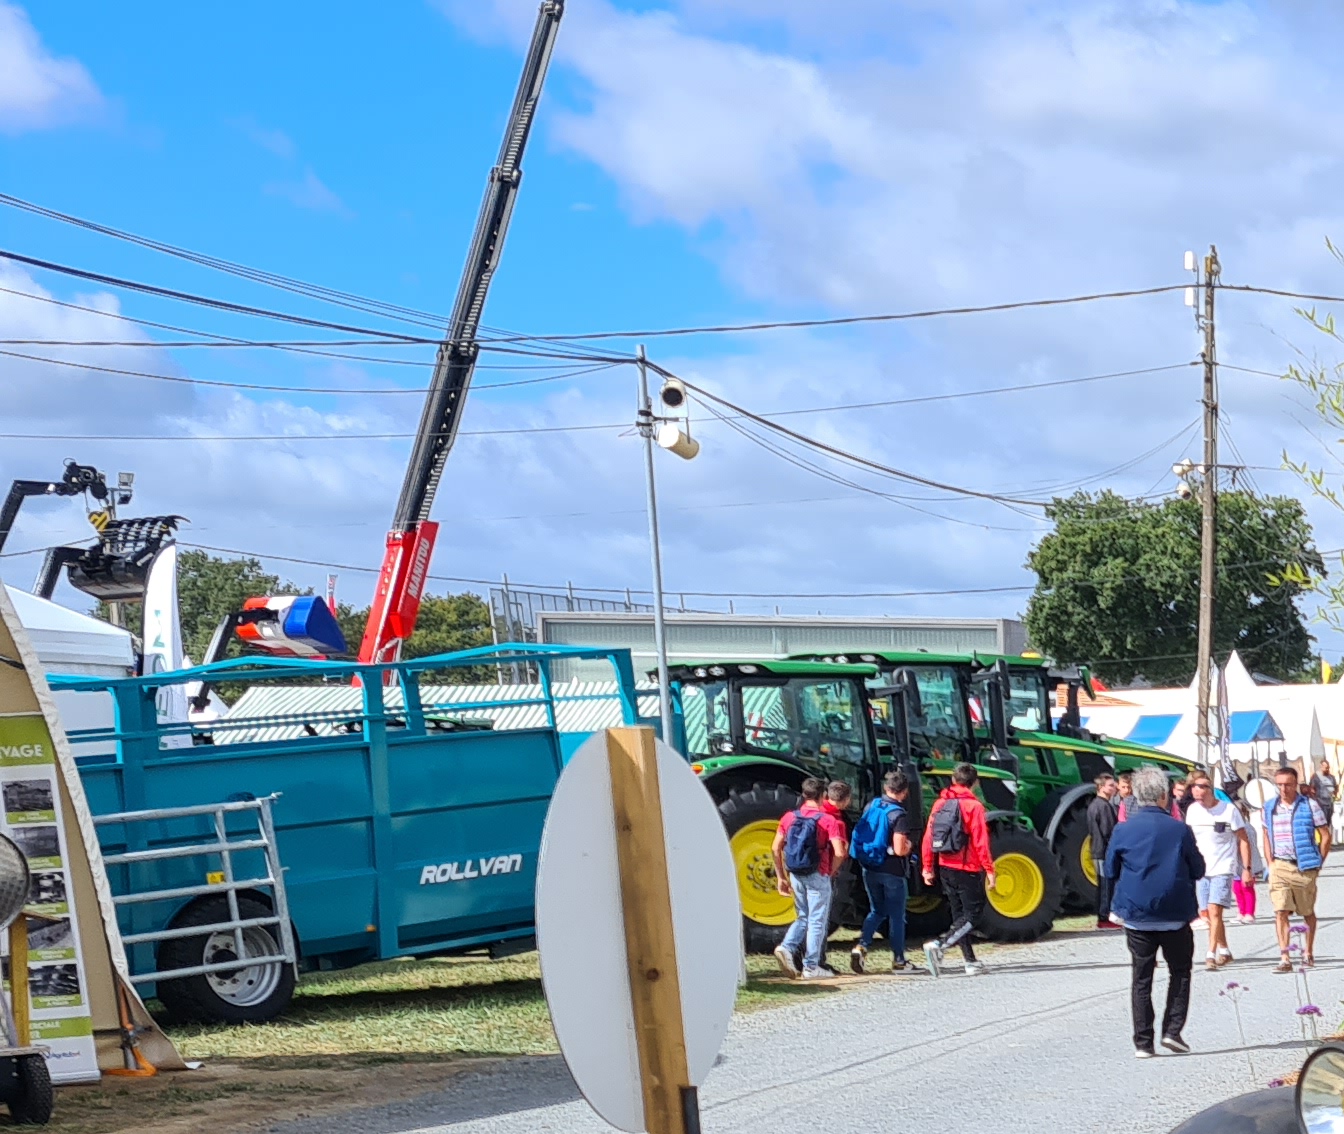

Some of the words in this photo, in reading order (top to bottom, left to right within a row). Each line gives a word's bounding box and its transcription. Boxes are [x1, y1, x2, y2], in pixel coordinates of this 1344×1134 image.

[407, 538, 430, 599] MANITOU
[0, 744, 43, 758] VAGE
[420, 854, 522, 885] ROLLVAN
